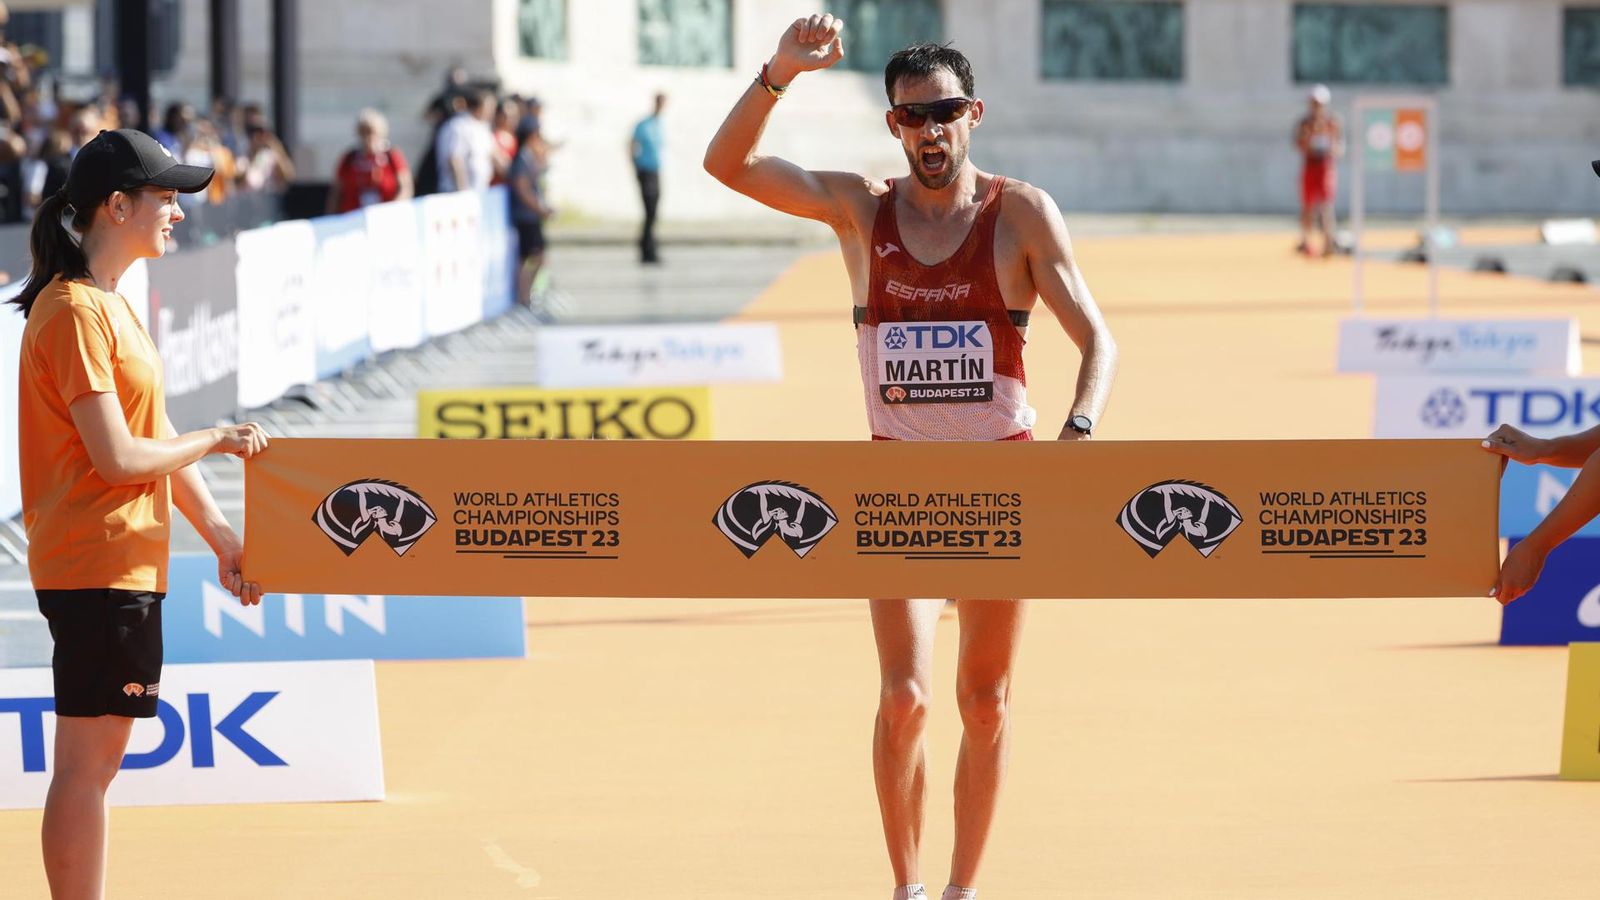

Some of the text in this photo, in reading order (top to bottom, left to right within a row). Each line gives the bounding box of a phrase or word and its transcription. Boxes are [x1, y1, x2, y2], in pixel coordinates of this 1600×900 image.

[885, 280, 971, 301] ESPAÑA
[906, 325, 984, 349] TDK
[885, 354, 984, 381] MARTÍN
[910, 388, 985, 398] BUDAPEST 23
[1469, 389, 1600, 427] TDK
[435, 396, 696, 439] SEIKO
[454, 492, 620, 507] WORLD ATHLETICS
[855, 493, 1022, 507] WORLD ATHLETICS
[1259, 491, 1427, 506] WORLD ATHLETICS
[453, 510, 620, 526] CHAMPIONSHIPS
[854, 511, 1022, 526] CHAMPIONSHIPS
[1259, 509, 1427, 525] CHAMPIONSHIPS
[455, 529, 620, 546] BUDAPEST 23
[856, 530, 1022, 547] BUDAPEST 23
[1261, 528, 1427, 546] BUDAPEST 23
